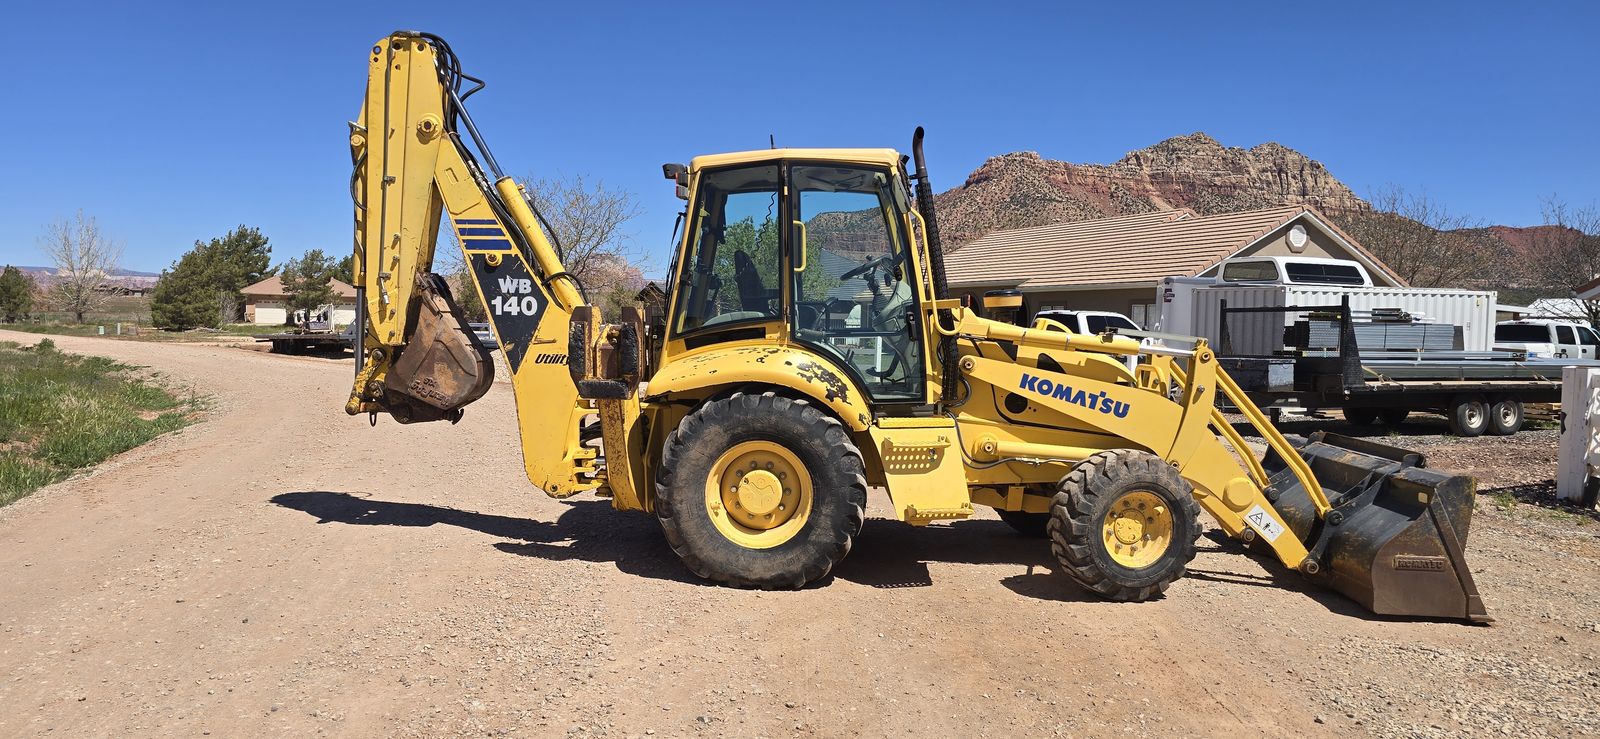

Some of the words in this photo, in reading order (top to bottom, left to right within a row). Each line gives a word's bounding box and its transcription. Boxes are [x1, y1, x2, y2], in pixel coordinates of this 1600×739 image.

[498, 278, 532, 294] WB
[491, 296, 538, 316] 140
[1019, 373, 1130, 418] KOMATSU
